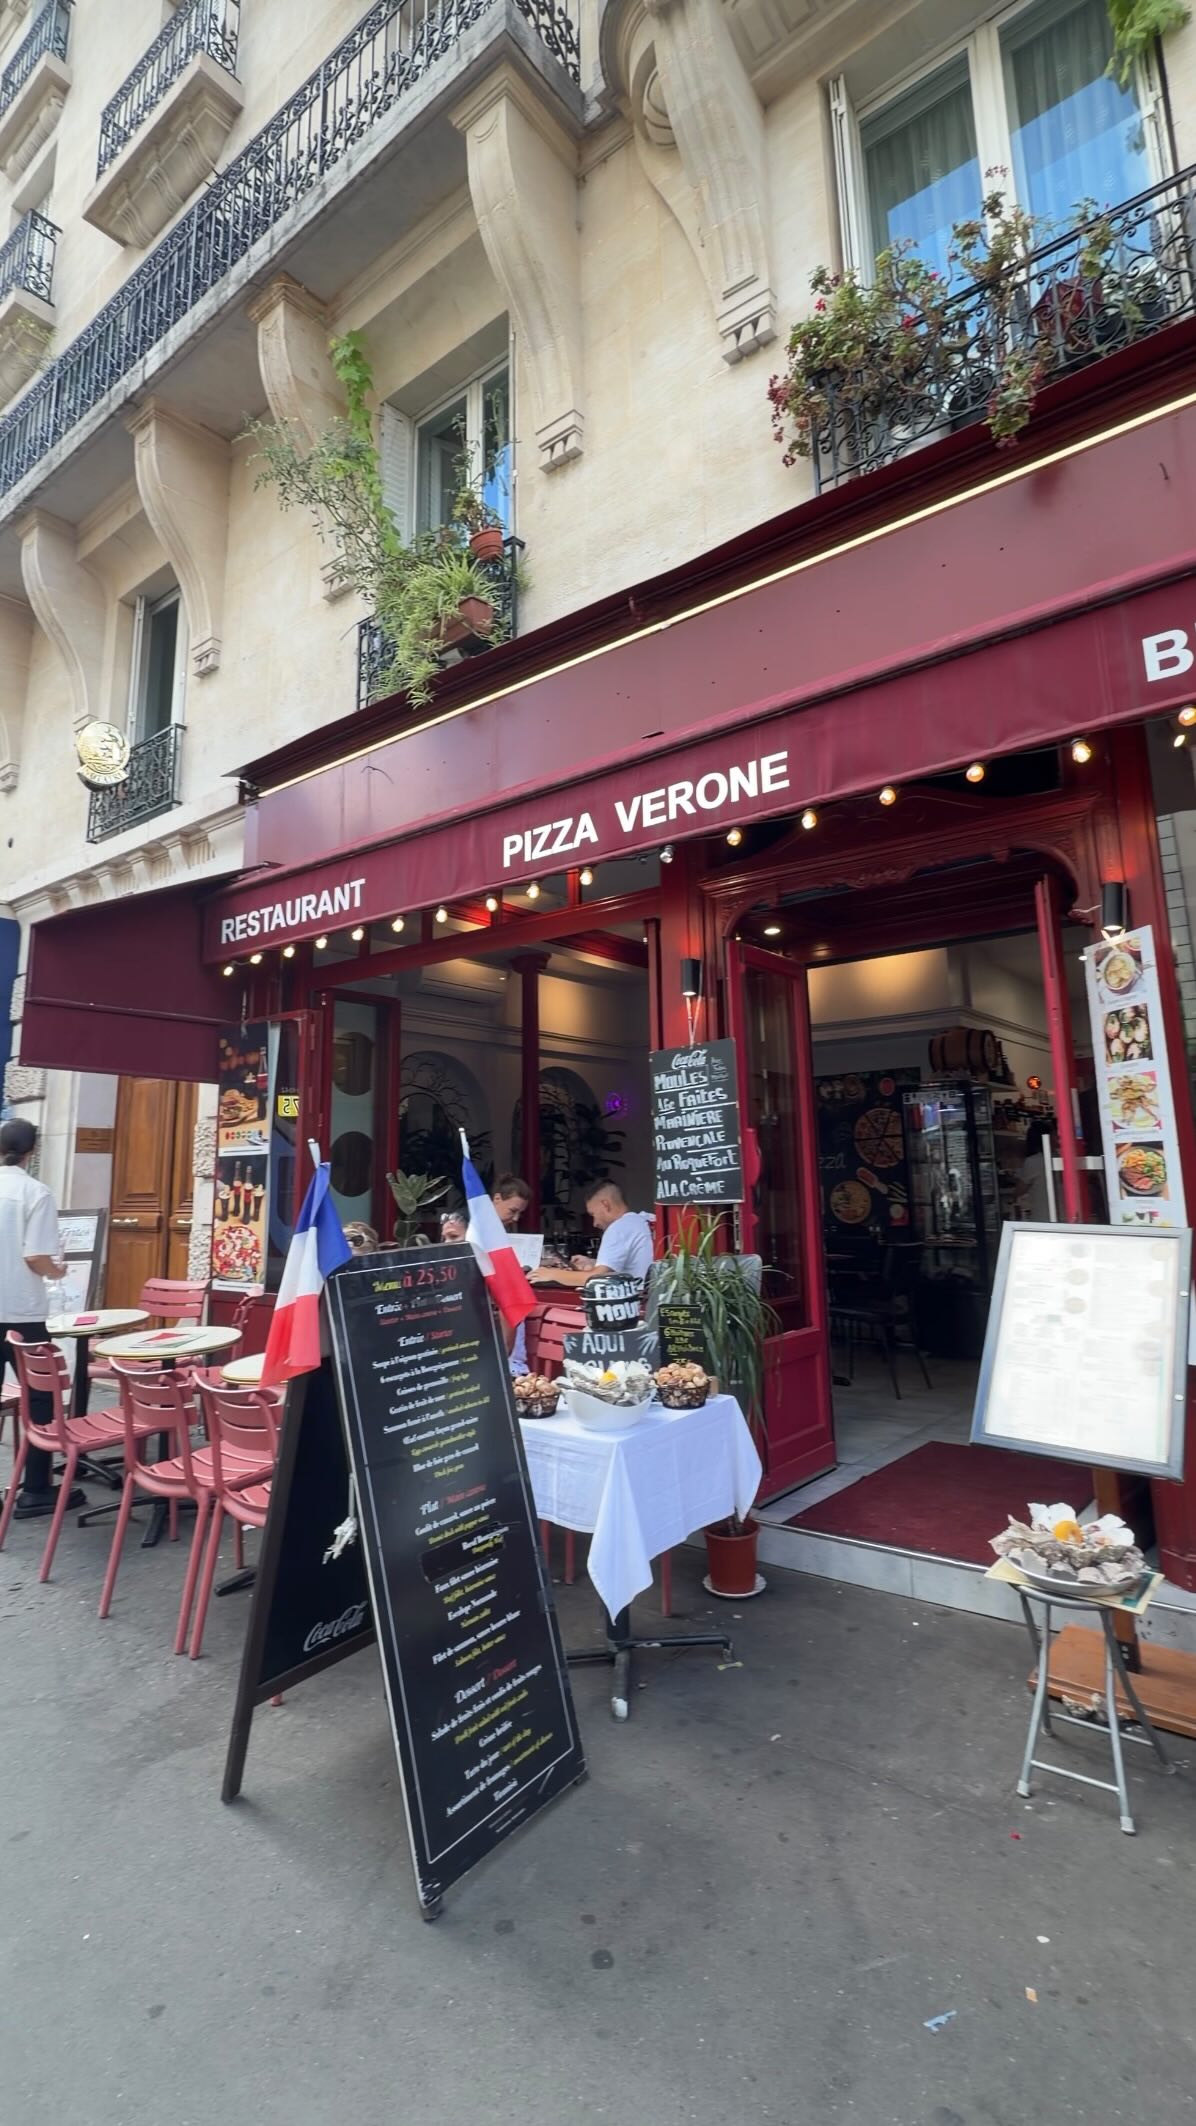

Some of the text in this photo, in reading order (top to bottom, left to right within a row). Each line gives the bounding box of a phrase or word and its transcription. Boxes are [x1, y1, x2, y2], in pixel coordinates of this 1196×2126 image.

[1142, 629, 1196, 682] B
[502, 750, 790, 868] PIZZA VERONE
[221, 878, 367, 943] RESTAURANT
[582, 1333, 625, 1355] AQUI
